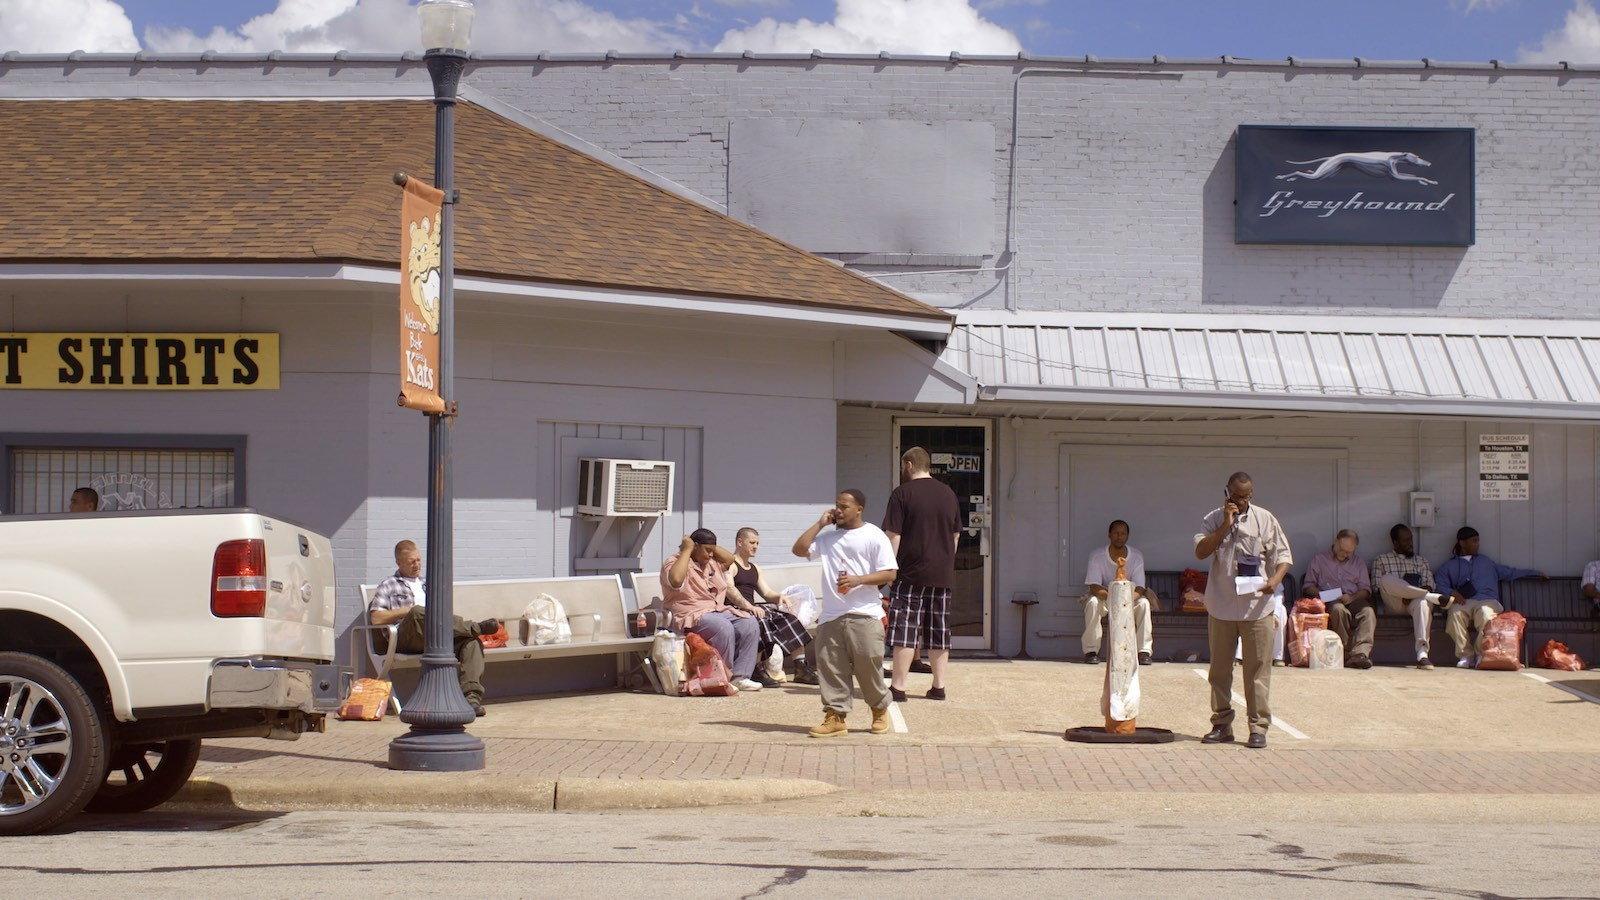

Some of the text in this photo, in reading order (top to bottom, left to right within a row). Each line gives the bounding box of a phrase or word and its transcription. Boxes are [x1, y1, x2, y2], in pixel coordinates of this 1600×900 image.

[1259, 190, 1456, 218] Greyhound
[0, 337, 260, 386] T SHIRTS
[405, 350, 434, 391] Kats
[949, 457, 979, 470] OPEN
